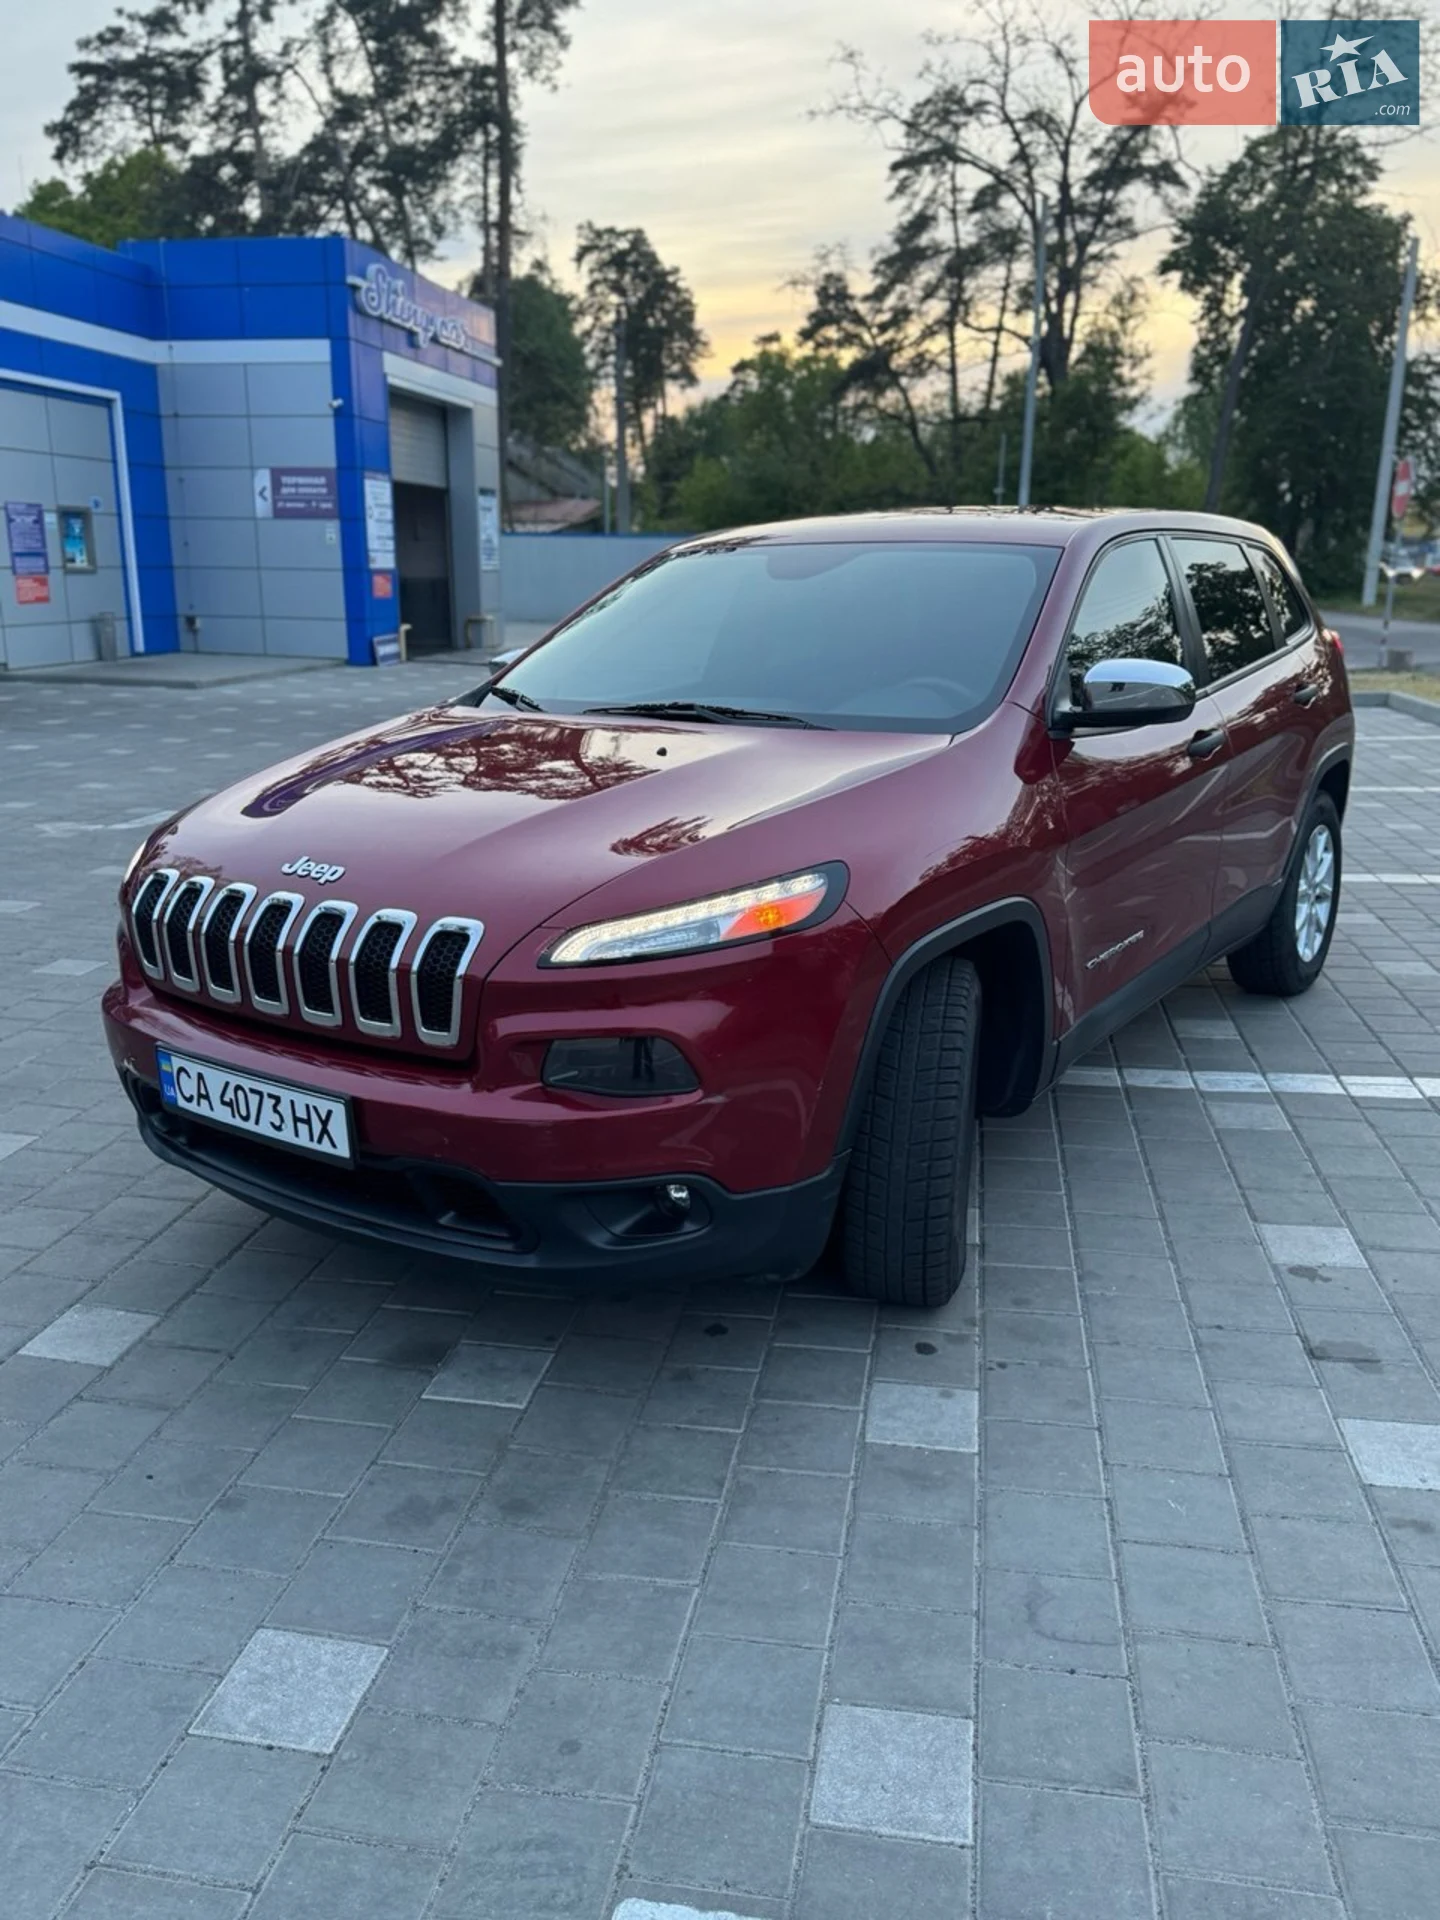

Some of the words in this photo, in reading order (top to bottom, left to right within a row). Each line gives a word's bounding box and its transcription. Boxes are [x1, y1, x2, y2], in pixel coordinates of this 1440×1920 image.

[281, 856, 346, 885] Jeep
[176, 1066, 213, 1112] CA
[220, 1081, 285, 1132] 4073
[291, 1099, 338, 1149] HX
